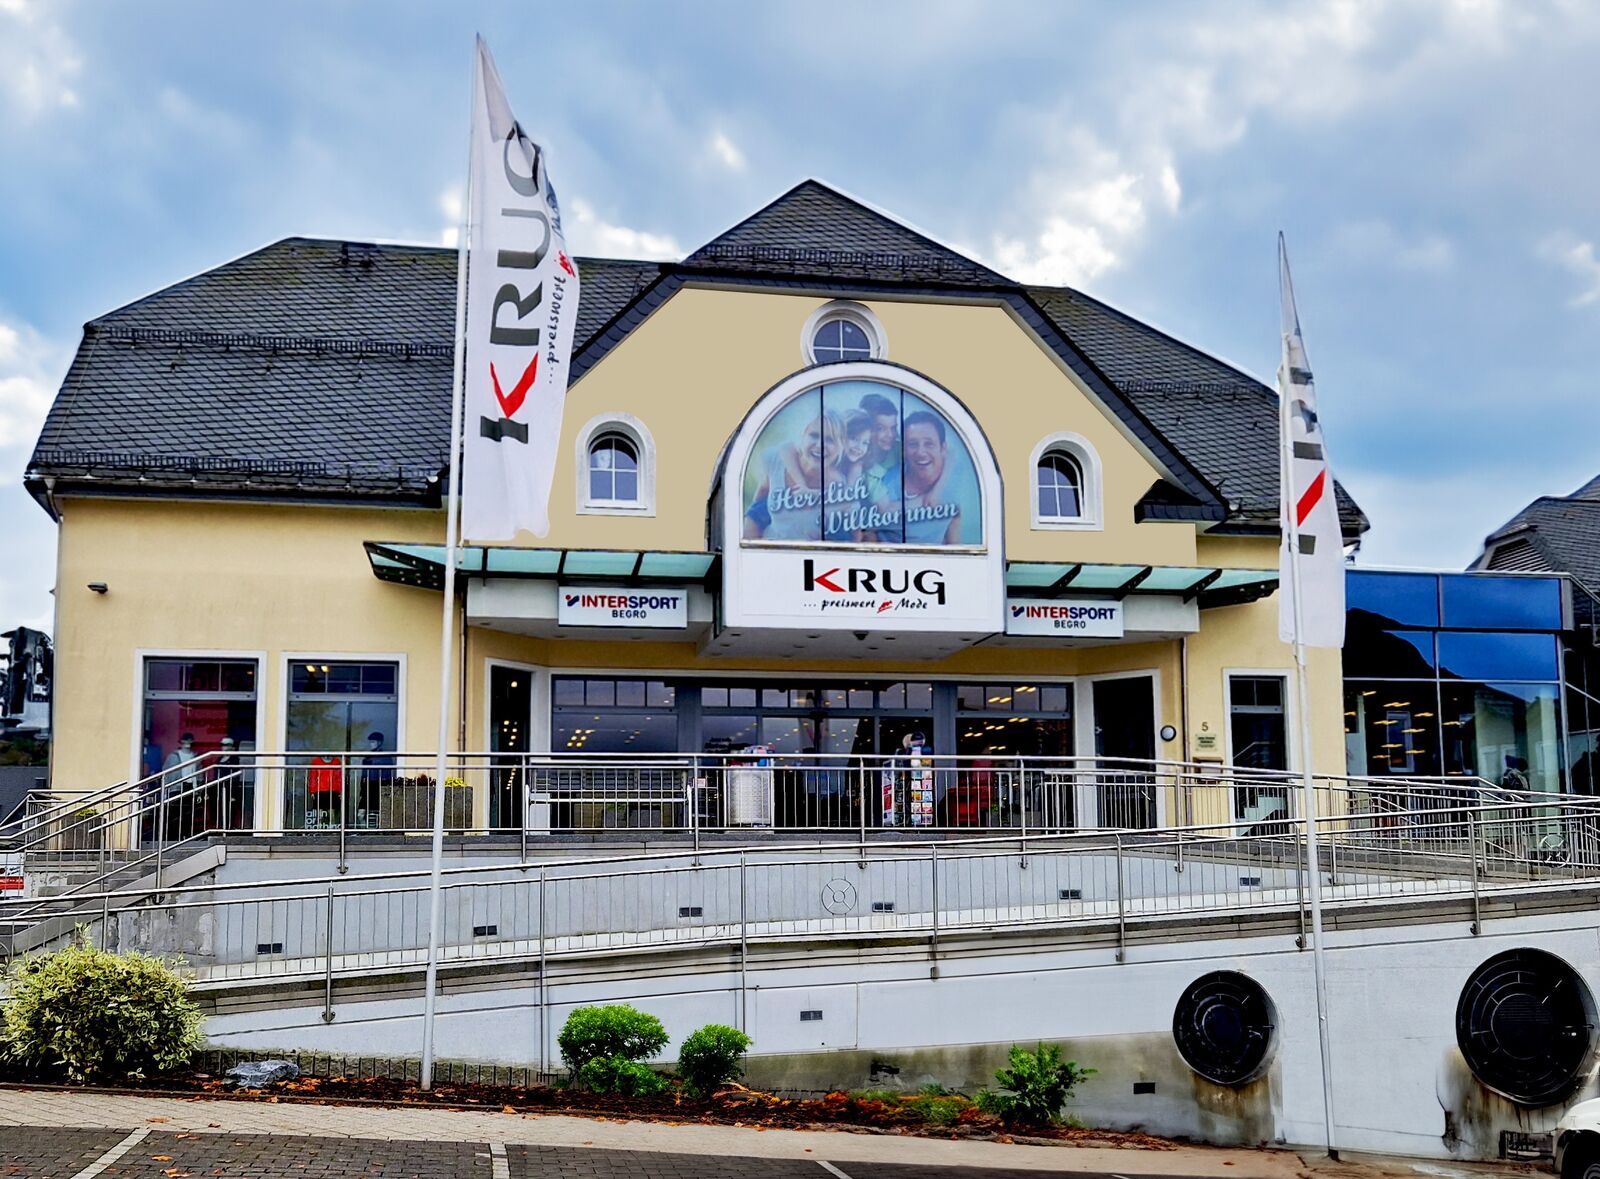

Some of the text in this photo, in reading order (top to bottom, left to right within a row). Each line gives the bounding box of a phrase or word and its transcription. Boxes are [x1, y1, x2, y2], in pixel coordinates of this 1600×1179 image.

[803, 559, 946, 605] KRUG
[581, 594, 680, 610] INTERSPORT
[894, 597, 928, 611] Mode
[612, 610, 647, 619] BEGRO
[1026, 605, 1116, 620] INTERSPORT
[1054, 620, 1087, 629] BEGRO
[1201, 721, 1209, 732] 5
